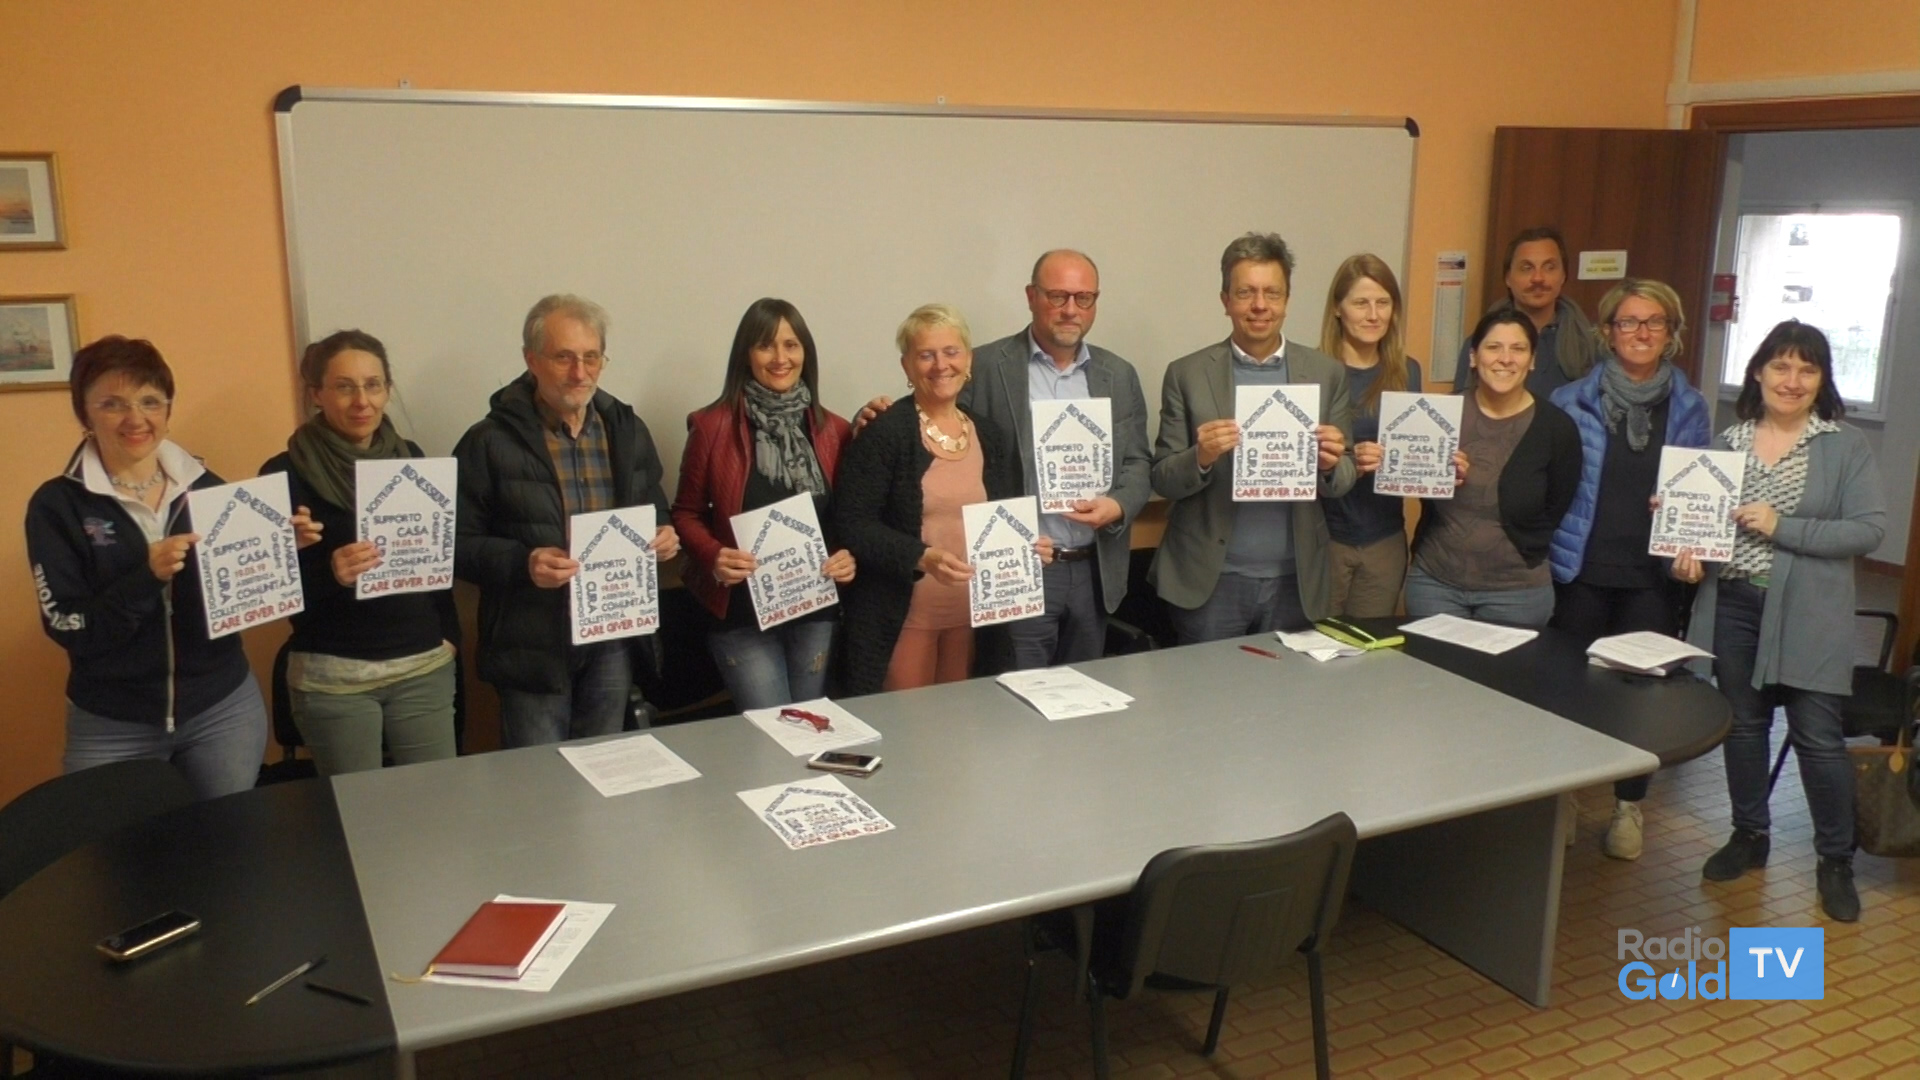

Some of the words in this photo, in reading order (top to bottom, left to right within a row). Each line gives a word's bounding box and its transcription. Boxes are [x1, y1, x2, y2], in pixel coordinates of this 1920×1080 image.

[1248, 431, 1288, 439] SUPPORTO
[1266, 442, 1294, 451] CASA
[1408, 445, 1435, 453] CASA
[1063, 455, 1090, 463] CASA
[1247, 448, 1257, 477] CURA
[1388, 449, 1399, 474] CURA
[1047, 462, 1057, 490] CURA
[1236, 488, 1260, 497] CARE
[1263, 488, 1289, 497] GIVER
[1294, 487, 1315, 496] DAY
[1377, 483, 1400, 492] CARE
[1403, 485, 1428, 494] GIVER
[1432, 487, 1453, 495] DAY
[1687, 503, 1715, 513] CASA
[374, 513, 422, 524] SUPPORTO
[397, 526, 429, 537] CASA
[213, 537, 261, 557] SUPPORTO
[1652, 543, 1676, 553] CARE
[1710, 549, 1731, 558] DAY
[238, 549, 270, 566] CASA
[585, 559, 626, 571] SUPPORTO
[778, 556, 806, 572] CASA
[998, 559, 1021, 570] CASA
[362, 580, 390, 594] CARE
[393, 576, 422, 589] GIVER
[428, 573, 451, 585] DAY
[605, 570, 634, 582] CASA
[217, 567, 231, 605] CURA
[761, 574, 775, 603] CURA
[981, 570, 991, 600] CURA
[586, 581, 597, 614] CURA
[212, 614, 241, 633] CARE
[244, 604, 275, 623] GIVER
[278, 596, 301, 613] DAY
[762, 609, 785, 625] CARE
[787, 599, 814, 616] GIVER
[816, 590, 835, 605] DAY
[973, 610, 996, 622] CARE
[999, 606, 1022, 618] GIVER
[1026, 601, 1043, 614] DAY
[580, 624, 605, 638] CARE
[607, 619, 633, 633] GIVER
[637, 614, 657, 627] DAY
